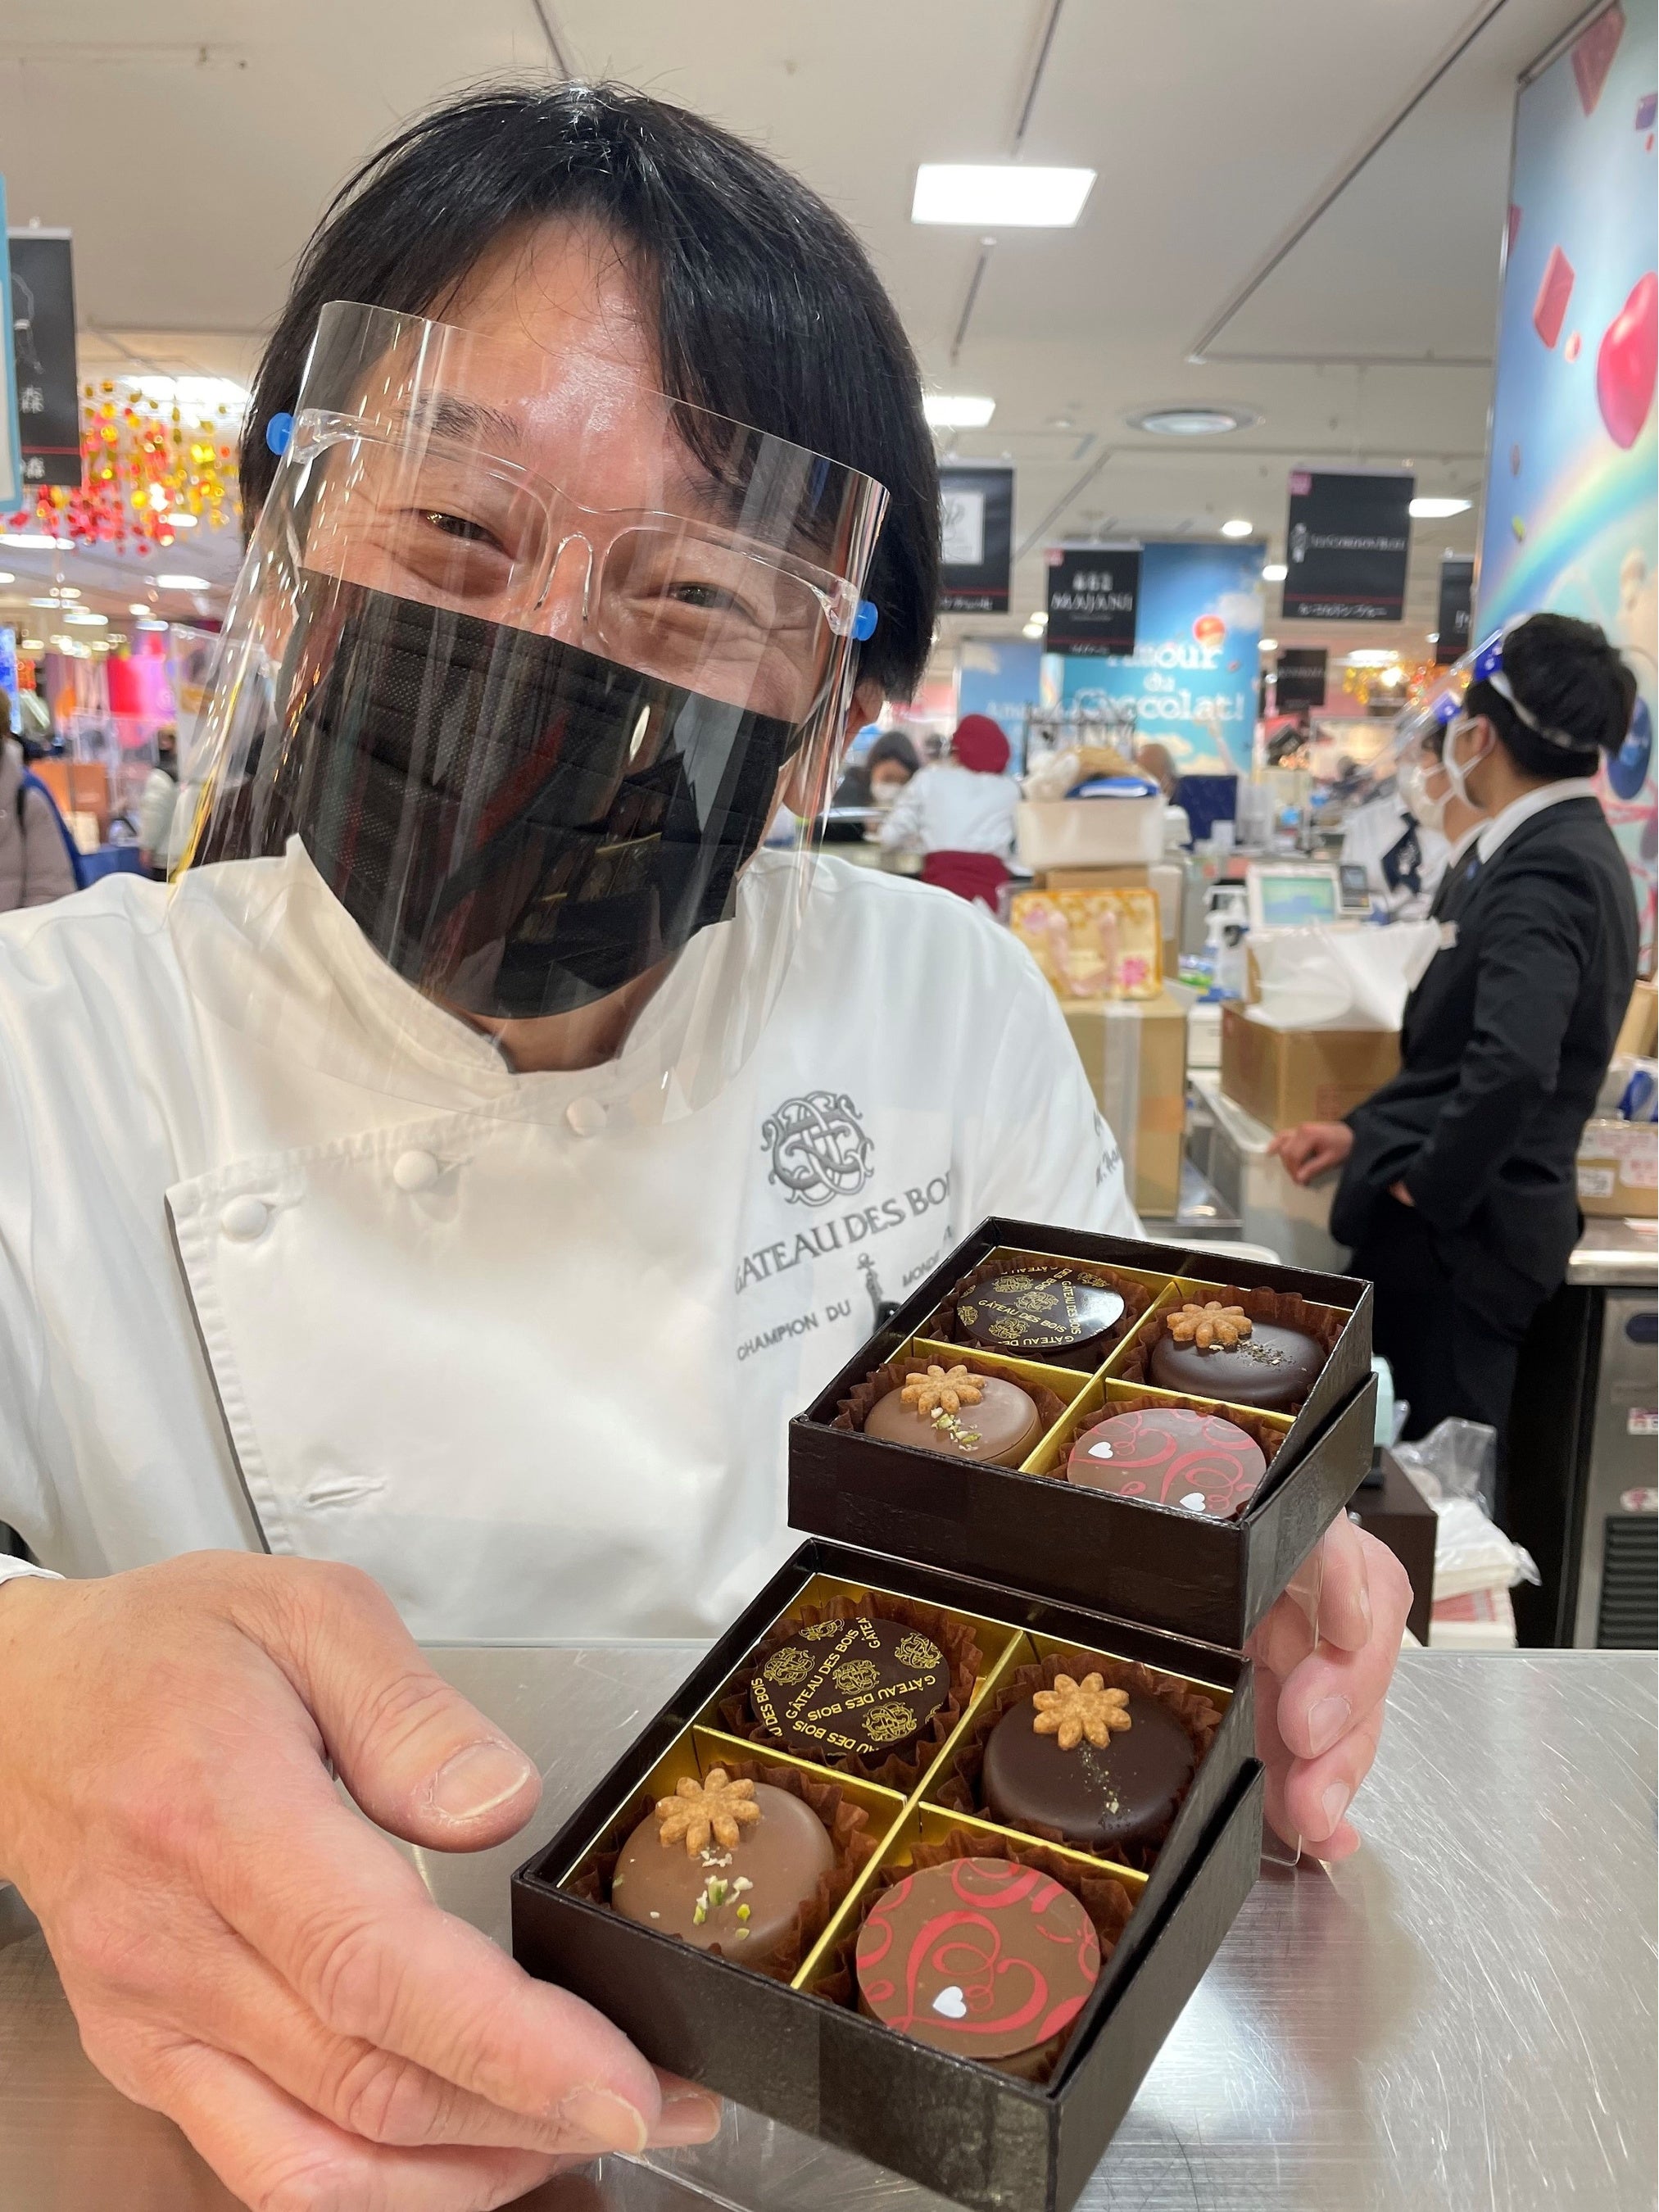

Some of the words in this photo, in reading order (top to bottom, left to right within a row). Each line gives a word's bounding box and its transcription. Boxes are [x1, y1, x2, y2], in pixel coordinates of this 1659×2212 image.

[1107, 641, 1224, 670] mour
[843, 1199, 906, 1244] DES
[1034, 1277, 1058, 1291] BOIS
[1062, 1281, 1077, 1304] GÂTEAU
[978, 1299, 1020, 1316] GÂTEAU
[1018, 1312, 1041, 1323] DES
[1040, 1320, 1067, 1333] BOIS
[737, 1312, 819, 1362] CHAMPION
[825, 1299, 852, 1322] DU
[1023, 1335, 1075, 1345] GÂTEAU
[855, 1617, 881, 1648] GÂTEA
[786, 1675, 823, 1720] GÂTEAU
[819, 1652, 841, 1675] DES
[835, 1629, 859, 1653] BOIS
[750, 1678, 769, 1704] BOIS
[878, 1675, 936, 1700] GÂTEAU
[807, 1703, 843, 1721] BOIS
[845, 1693, 875, 1710] DES
[760, 1703, 778, 1726] DES
[792, 1720, 827, 1739] BOIS
[827, 1732, 857, 1750] DES
